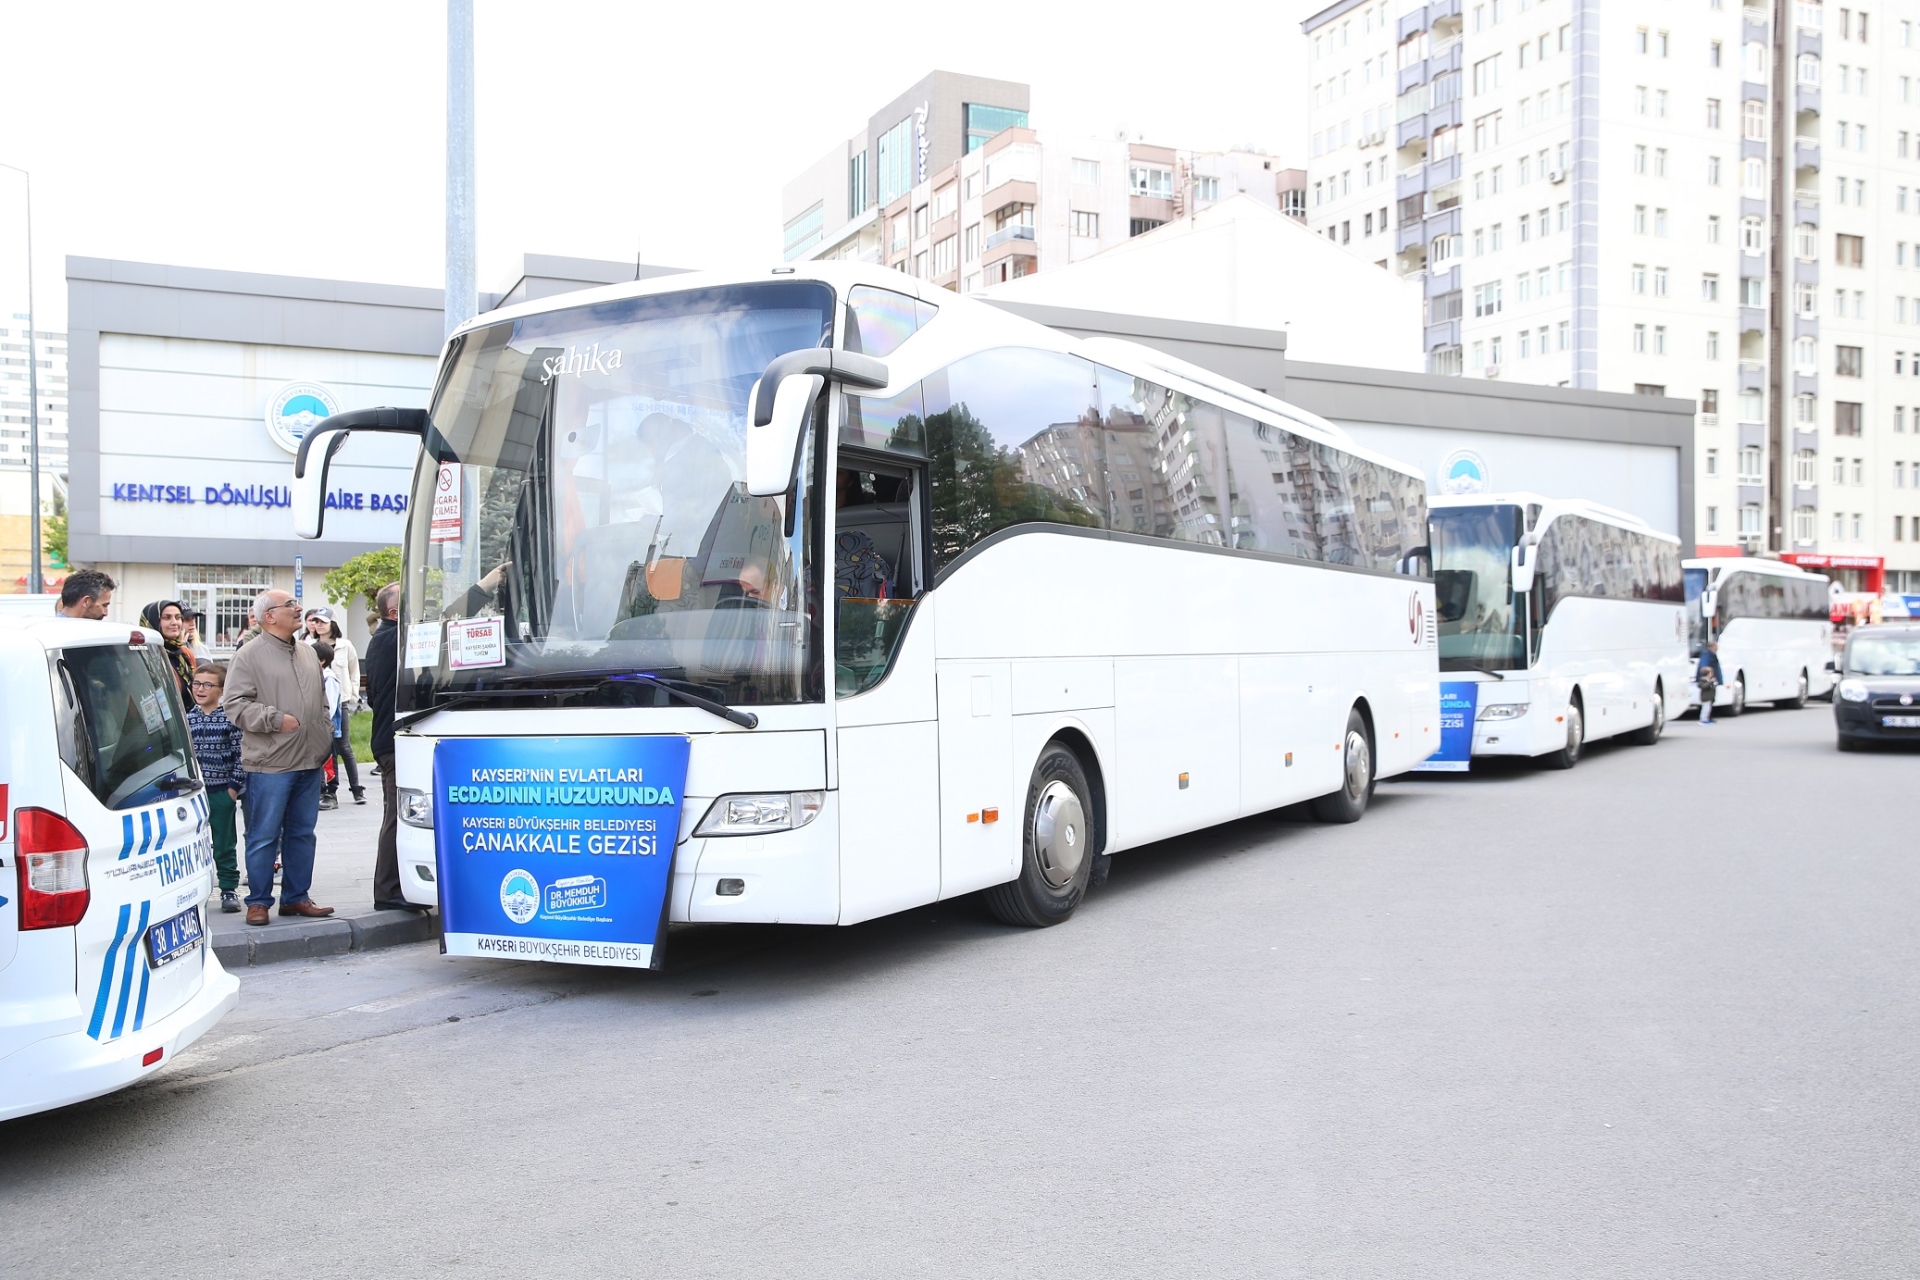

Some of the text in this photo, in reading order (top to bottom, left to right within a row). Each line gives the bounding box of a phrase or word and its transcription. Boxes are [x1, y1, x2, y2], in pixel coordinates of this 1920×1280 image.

[113, 483, 408, 515] KENTSEL DÖNÜŞÜ AİRE BAŞ
[466, 627, 493, 639] TÜRSAB
[1440, 719, 1465, 728] EZİSİ
[559, 768, 643, 783] EVLATLARI
[448, 785, 675, 806] ECDADININ HUZURUNDA
[462, 816, 657, 832] KAYSERİ BÜYÜKŞEHİR BELEDİYESİ
[462, 832, 657, 856] ÇANAKKALE GEZİSİ
[104, 858, 156, 878] TOURNEO
[551, 885, 600, 901] DR. MEMDUH
[550, 895, 597, 910] BÜYÜKKILIÇ
[155, 926, 167, 954] 38
[171, 921, 179, 947] A
